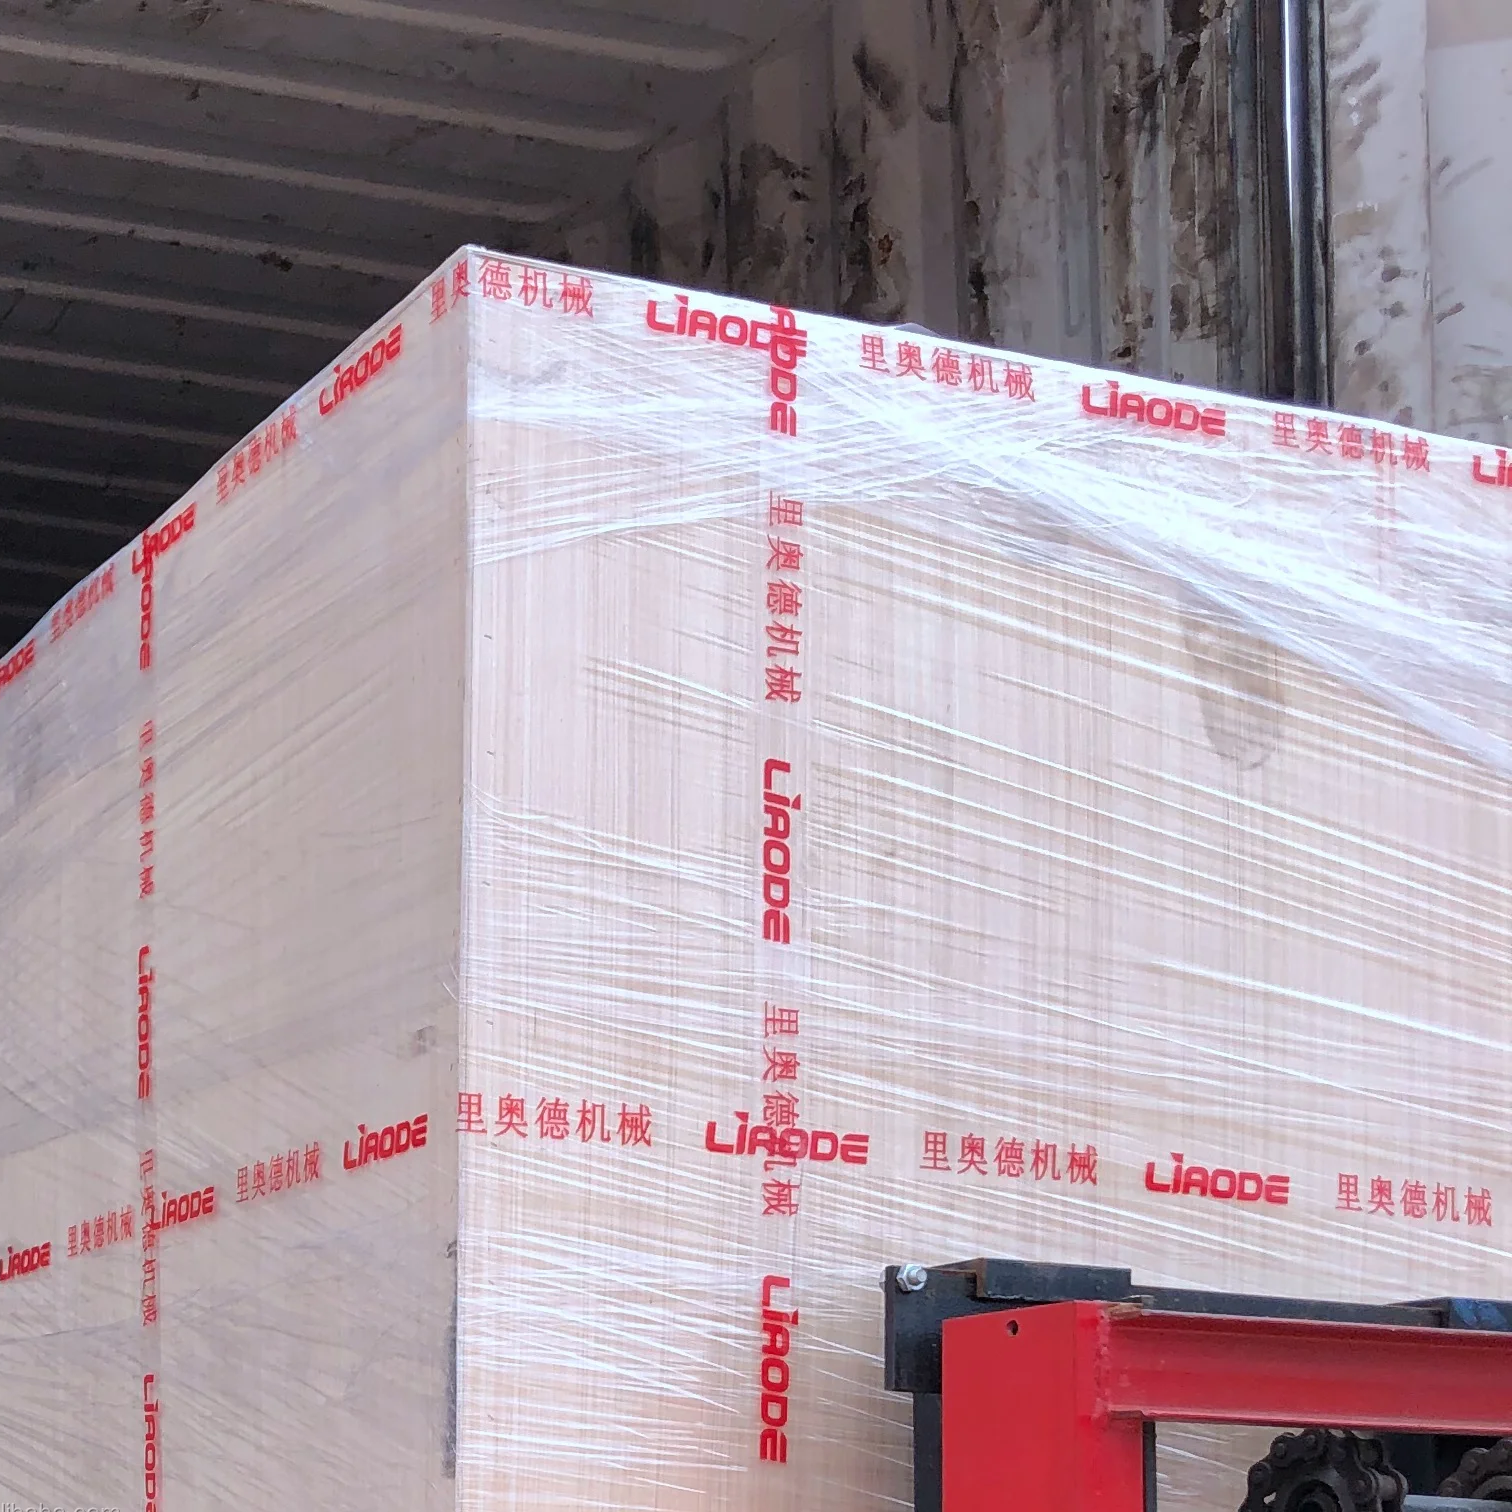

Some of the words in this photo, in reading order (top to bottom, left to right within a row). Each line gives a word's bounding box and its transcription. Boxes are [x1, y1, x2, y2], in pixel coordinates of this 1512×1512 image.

[215, 405, 297, 505] 里奥德机械
[859, 333, 1035, 402] 里奥德机械
[1272, 411, 1430, 473] 里奥德机械
[764, 490, 803, 703] 里奥德机械
[67, 1204, 133, 1257] 里奥德机械
[236, 1142, 320, 1202] 里奥德机械
[455, 1092, 652, 1147] 里奥德机械
[919, 1131, 1098, 1186] 里奥德机械
[1335, 1172, 1492, 1227] 里奥德机械
